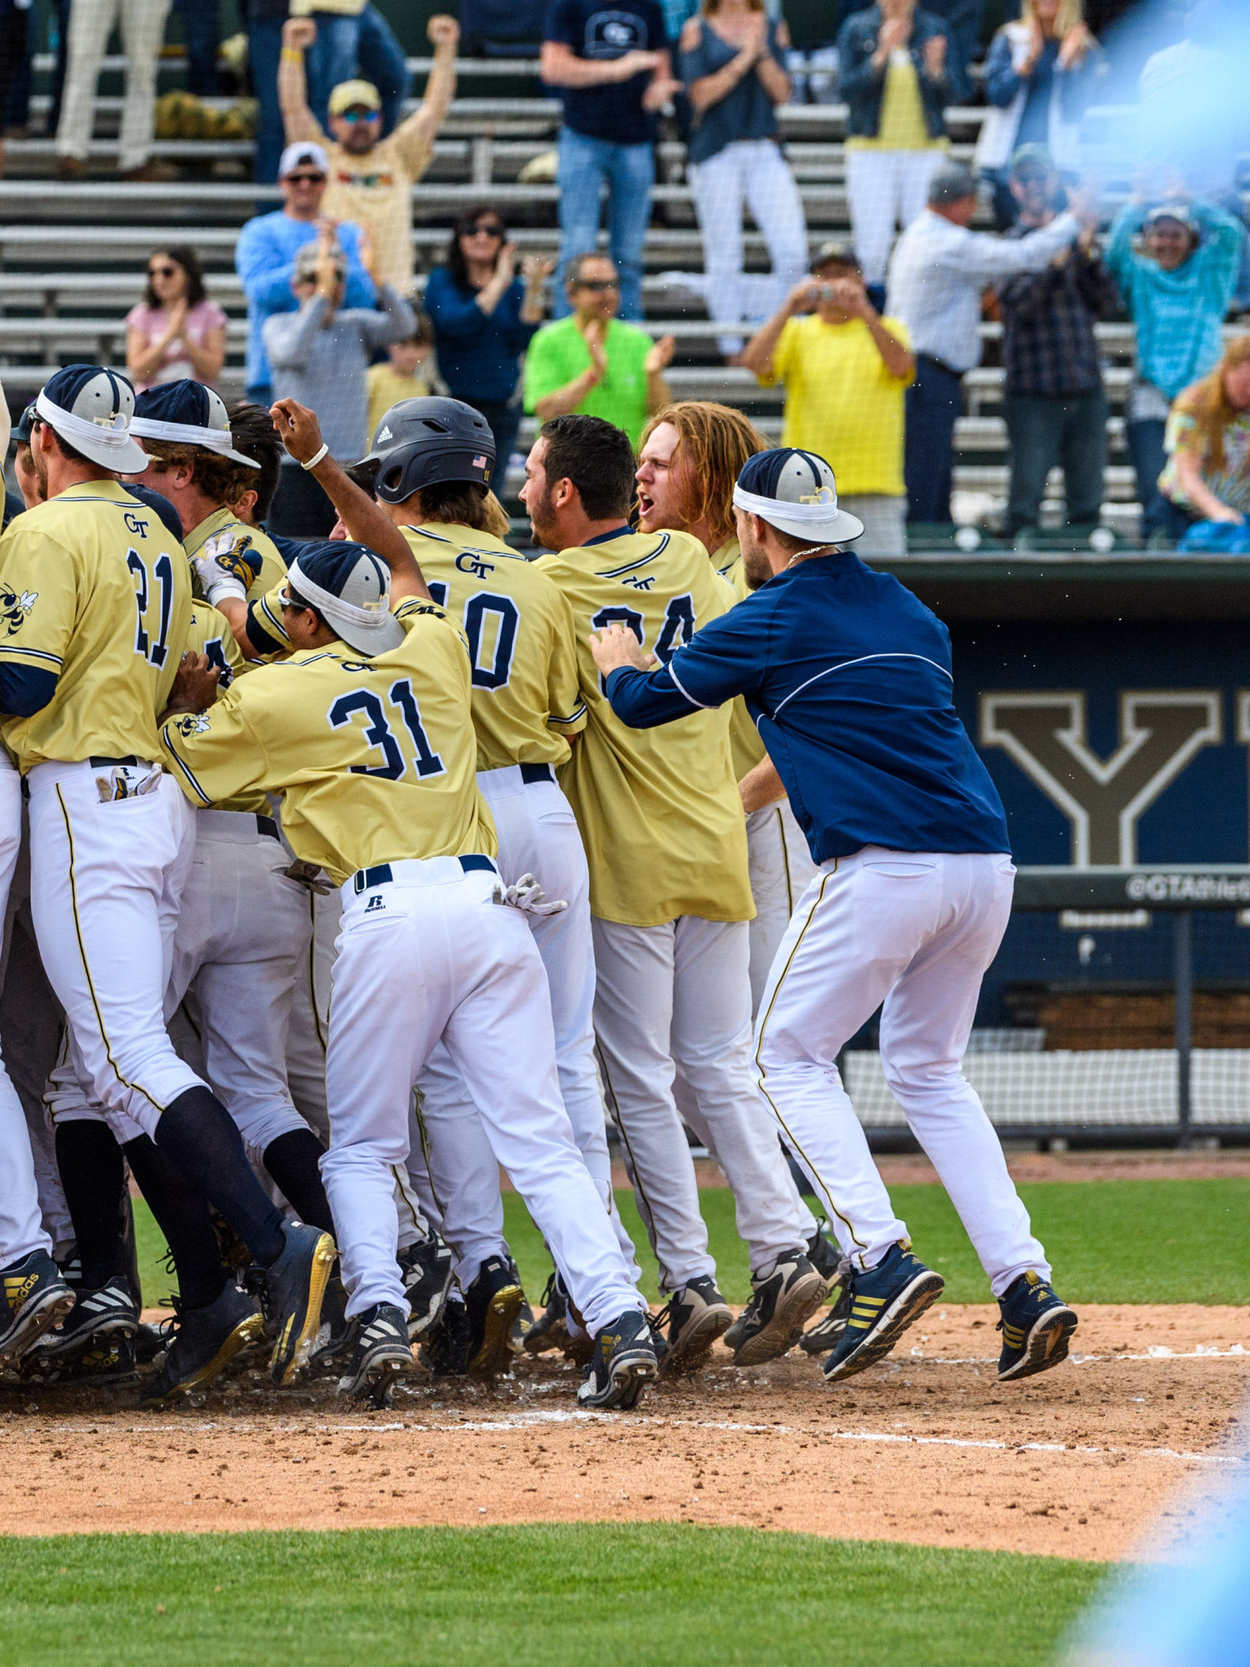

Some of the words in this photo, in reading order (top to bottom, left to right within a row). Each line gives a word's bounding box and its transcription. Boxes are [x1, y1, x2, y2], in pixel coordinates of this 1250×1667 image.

[124, 512, 149, 539] GT
[455, 552, 495, 580] GT
[326, 677, 448, 781] 31
[980, 689, 1250, 868] Y
[1126, 874, 1250, 900] @GTAthlet
